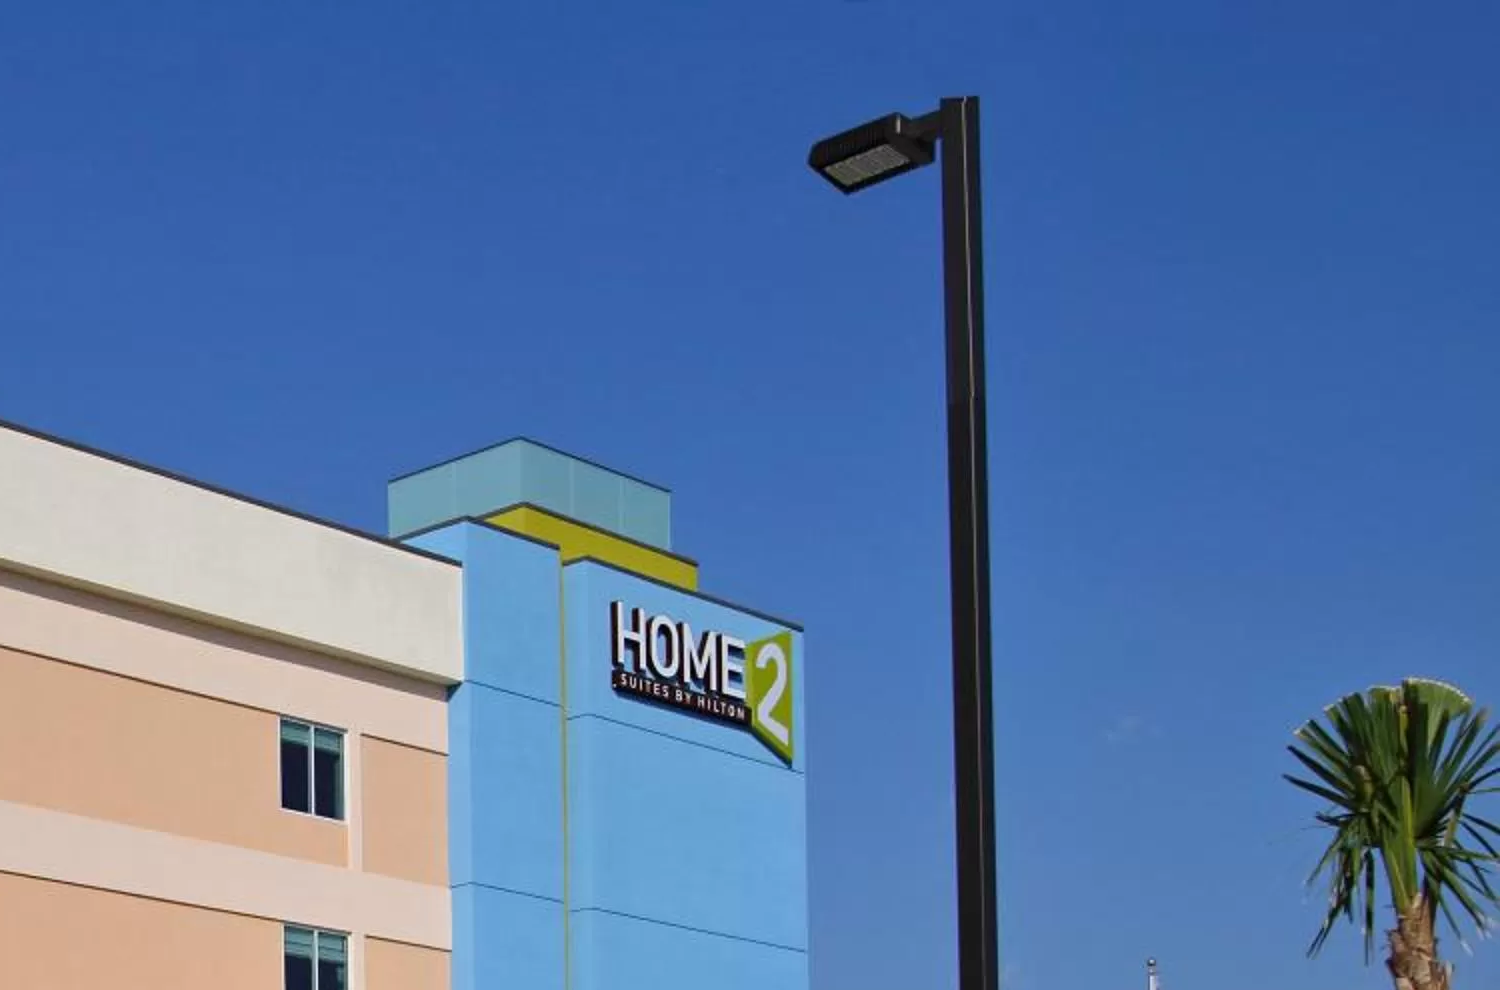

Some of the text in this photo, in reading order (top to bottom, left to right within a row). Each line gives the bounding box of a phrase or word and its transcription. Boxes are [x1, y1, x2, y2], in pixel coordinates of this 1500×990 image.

[614, 600, 789, 747] HOME 2
[620, 673, 745, 721] SUITES BY HILTON
